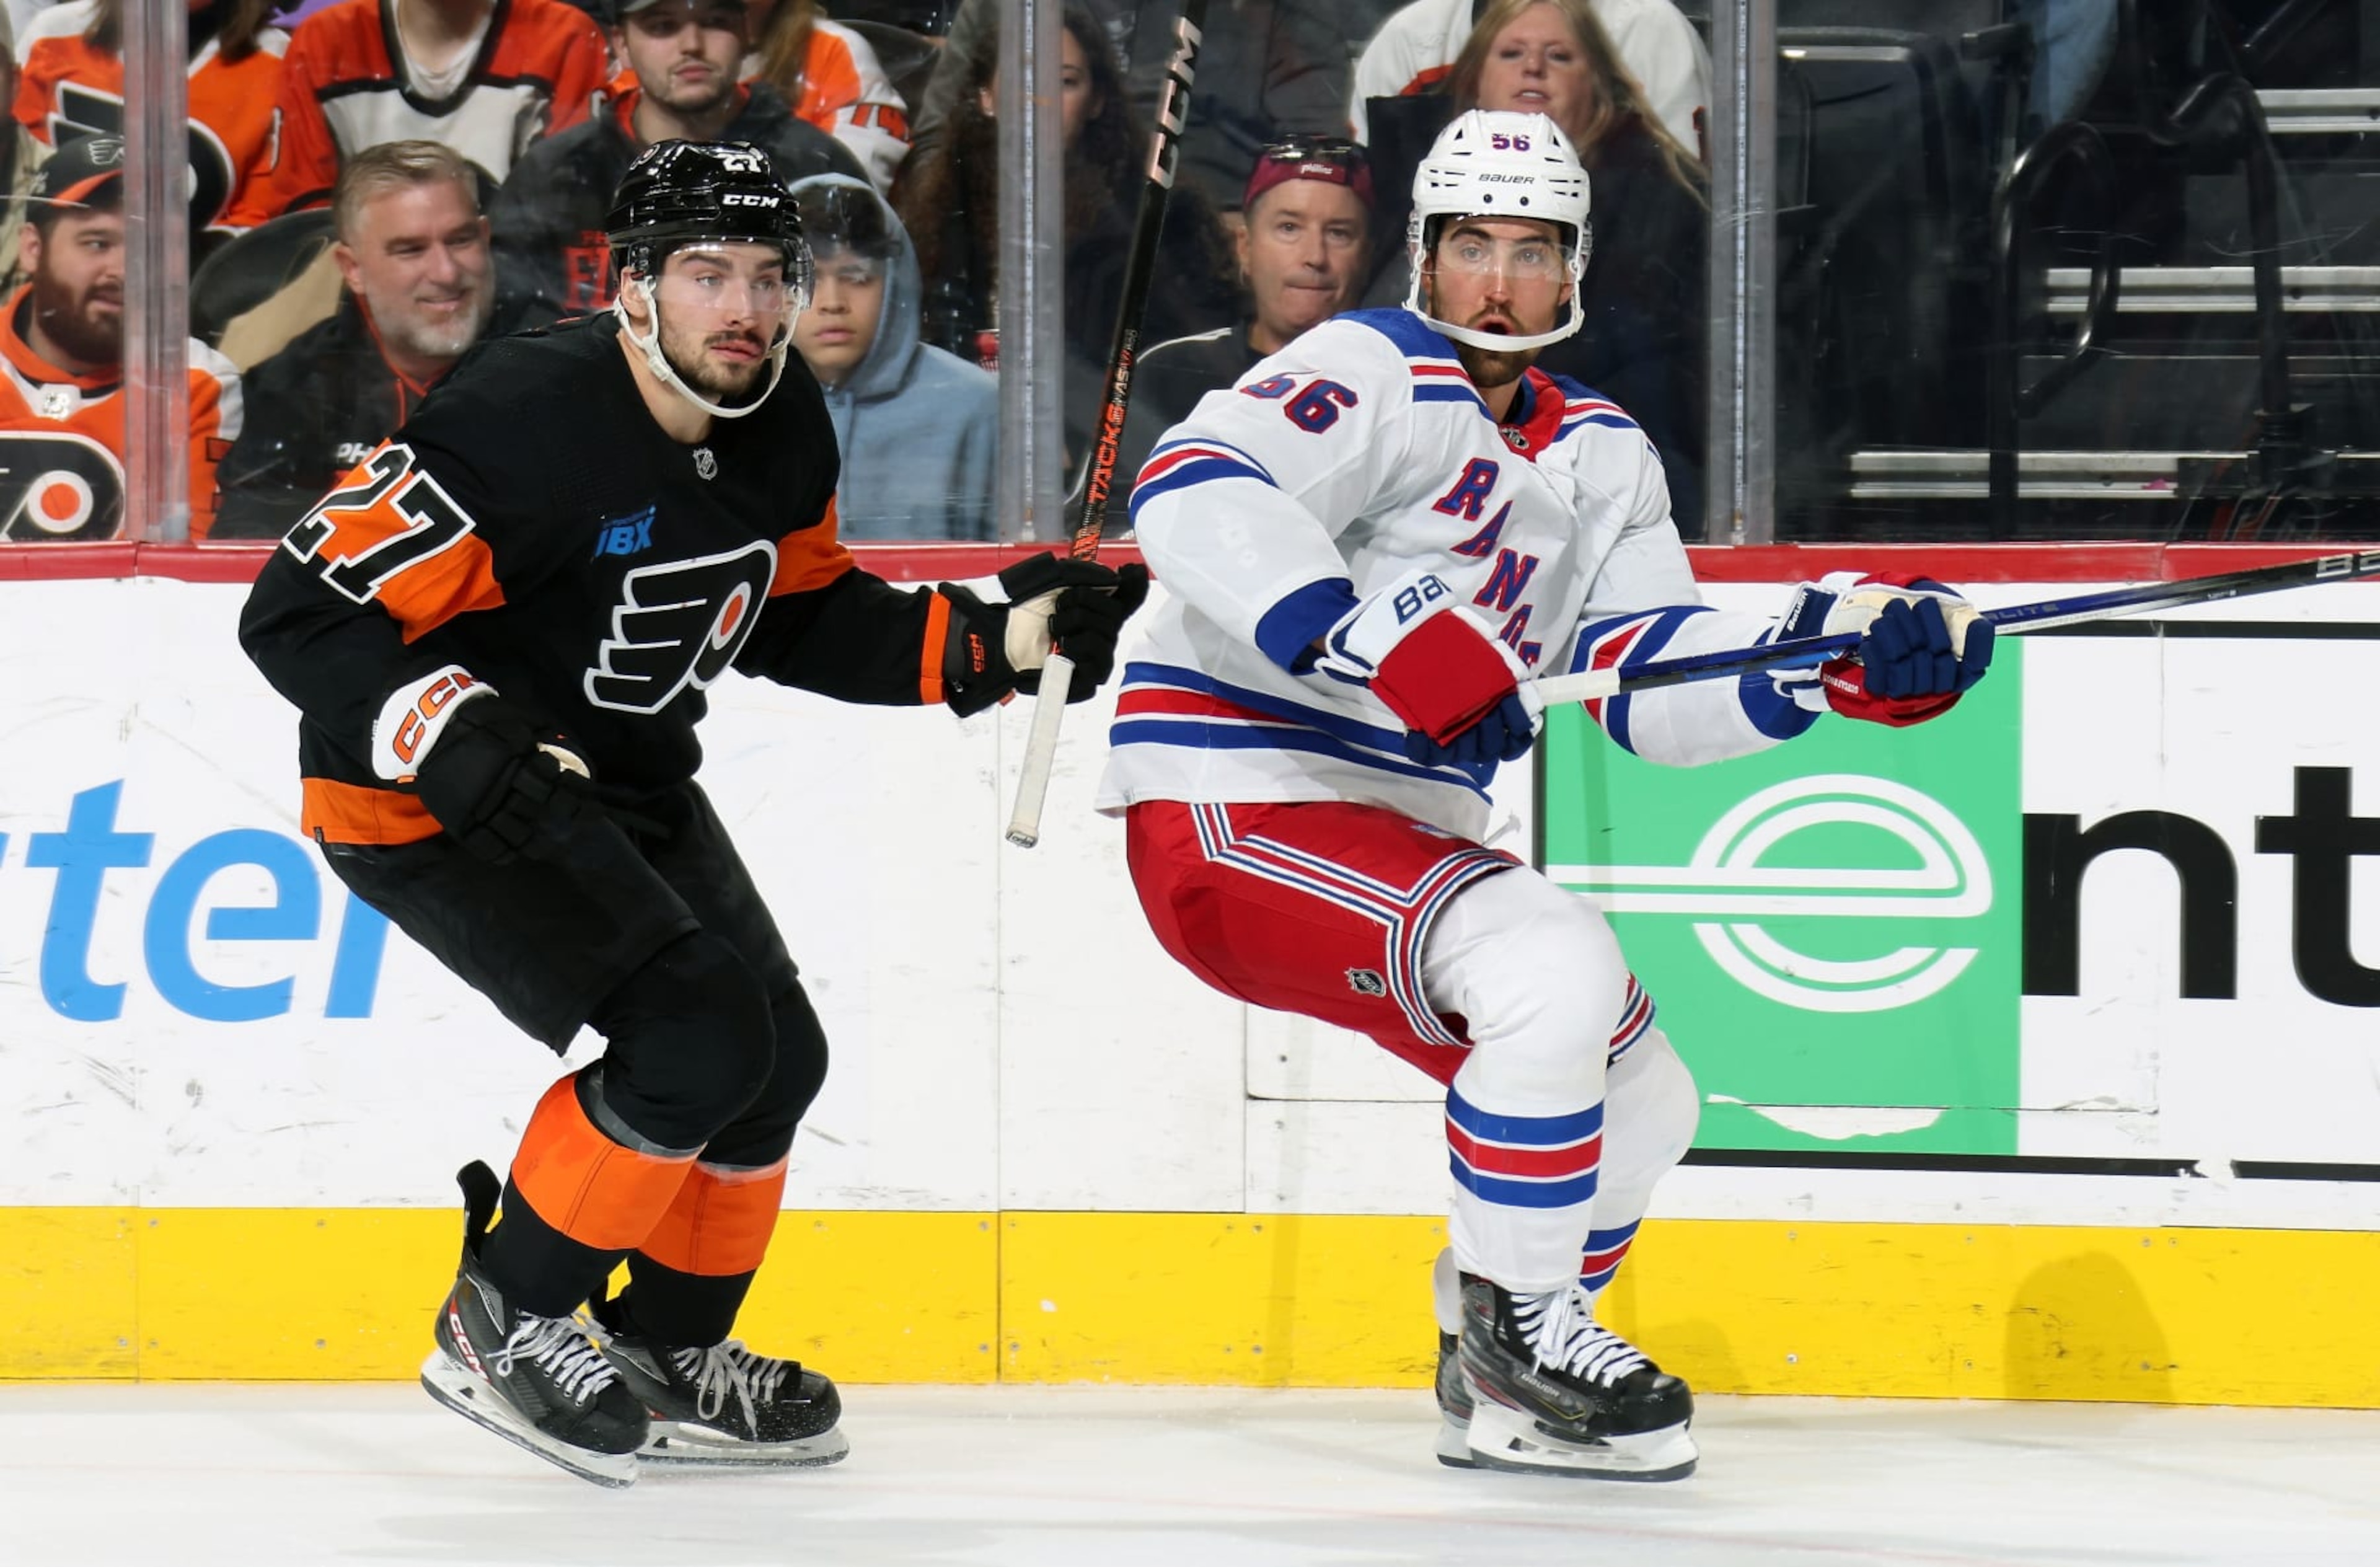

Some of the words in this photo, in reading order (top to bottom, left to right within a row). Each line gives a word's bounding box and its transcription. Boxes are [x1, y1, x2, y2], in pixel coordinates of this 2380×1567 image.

[1145, 16, 1202, 190] CCM
[1491, 133, 1530, 152] 56
[1479, 174, 1535, 184] BAUER
[722, 194, 780, 208] CCM
[281, 443, 477, 605] 27
